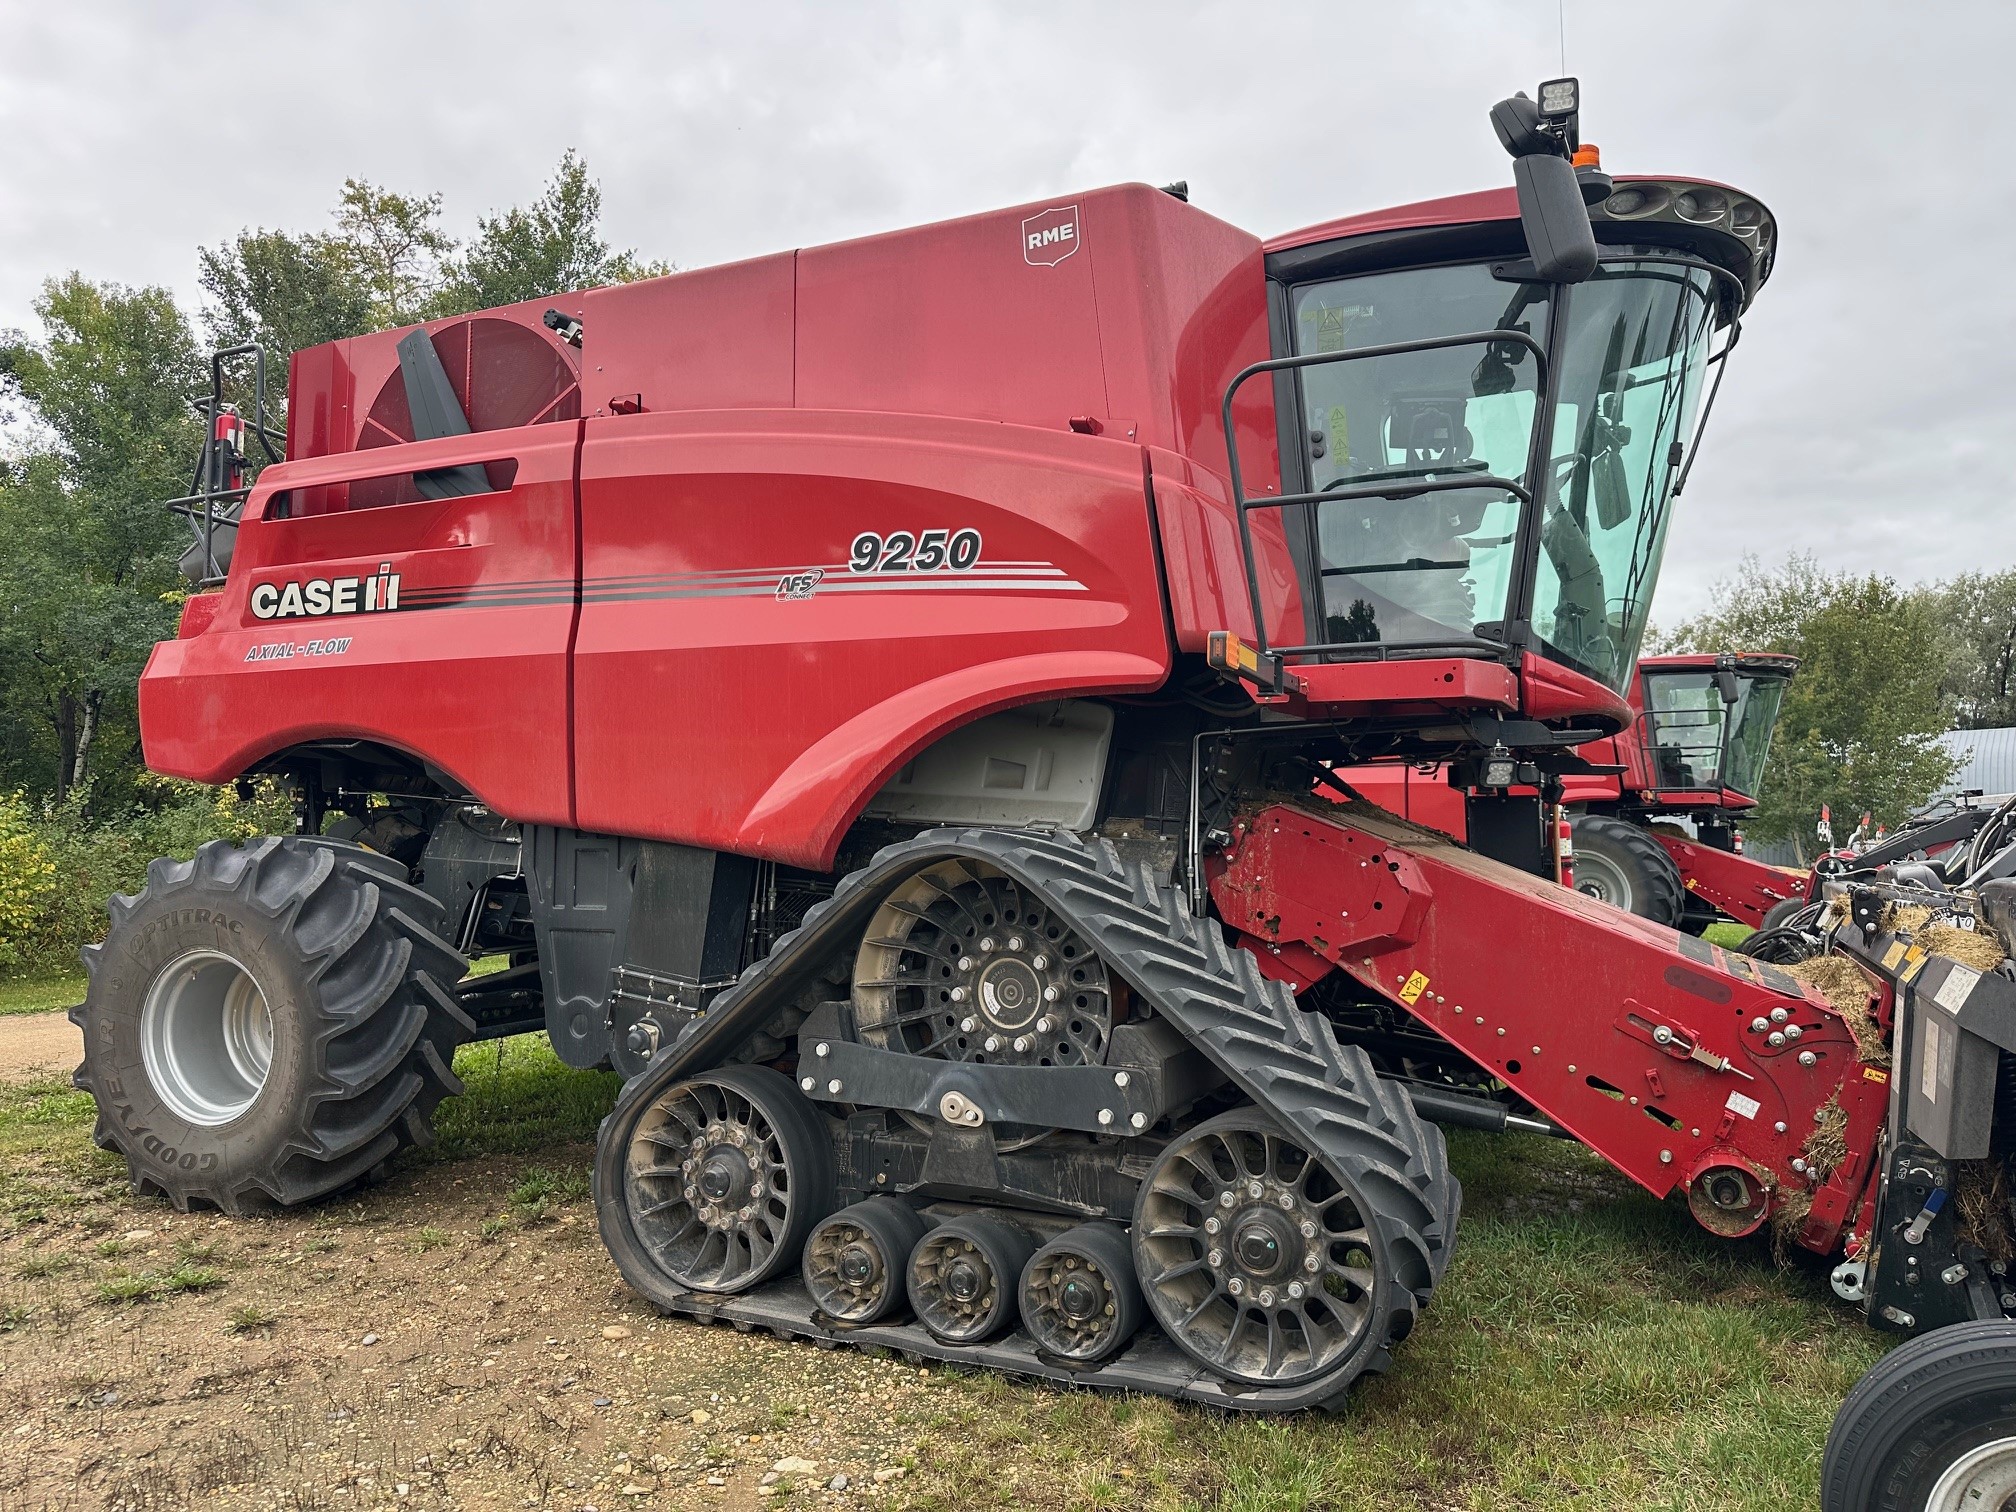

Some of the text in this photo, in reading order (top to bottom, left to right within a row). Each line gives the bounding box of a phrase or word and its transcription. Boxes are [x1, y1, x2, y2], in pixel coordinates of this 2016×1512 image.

[1028, 222, 1074, 250] RME
[848, 528, 983, 574] 9250
[250, 577, 359, 620] CASE
[776, 575, 814, 594] AFS
[784, 592, 815, 600] CONNECT
[244, 637, 353, 662] AXIAL-FLOW
[129, 908, 244, 955] OPTITRAC
[99, 1017, 219, 1173] GOODYEAR
